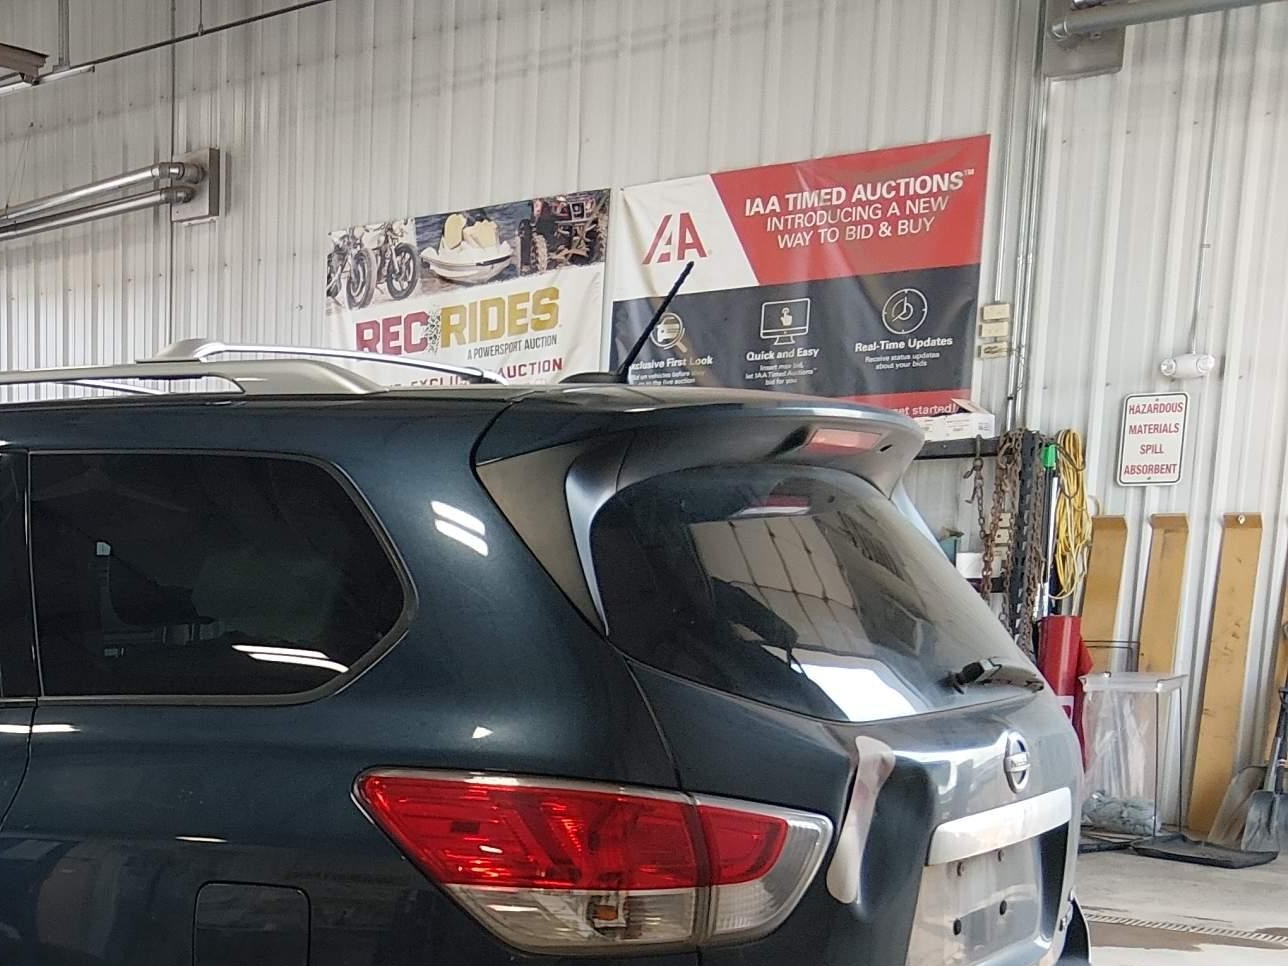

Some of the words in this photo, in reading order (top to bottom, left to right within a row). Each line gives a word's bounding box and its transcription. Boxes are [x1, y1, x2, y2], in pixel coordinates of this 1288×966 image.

[745, 198, 781, 216] IAA
[785, 187, 847, 212] TIMED
[766, 203, 883, 232] INTRODUCING
[886, 204, 900, 218] A
[905, 195, 950, 215] NEW
[777, 230, 814, 249] WAY
[817, 227, 840, 244] TO
[844, 223, 874, 241] BID
[877, 222, 893, 237] &
[897, 217, 936, 236] BUY
[355, 311, 430, 356] REC
[440, 286, 560, 349] RIDES
[473, 341, 522, 359] POWERSPORT
[524, 334, 558, 350] AUCTION
[855, 340, 906, 352] Real-Time
[908, 337, 953, 349] Updates
[666, 357, 686, 367] First
[689, 355, 713, 366] Look
[746, 350, 775, 361] Quick
[776, 348, 795, 359] and
[796, 347, 820, 358] Easy
[912, 352, 940, 360] updates
[497, 358, 563, 378] AUCTION
[1128, 402, 1184, 415] HAZARDOUS
[1128, 423, 1180, 435] MATERIALS
[1139, 443, 1164, 455] SPILL
[1124, 463, 1177, 475] ABSORBENT
